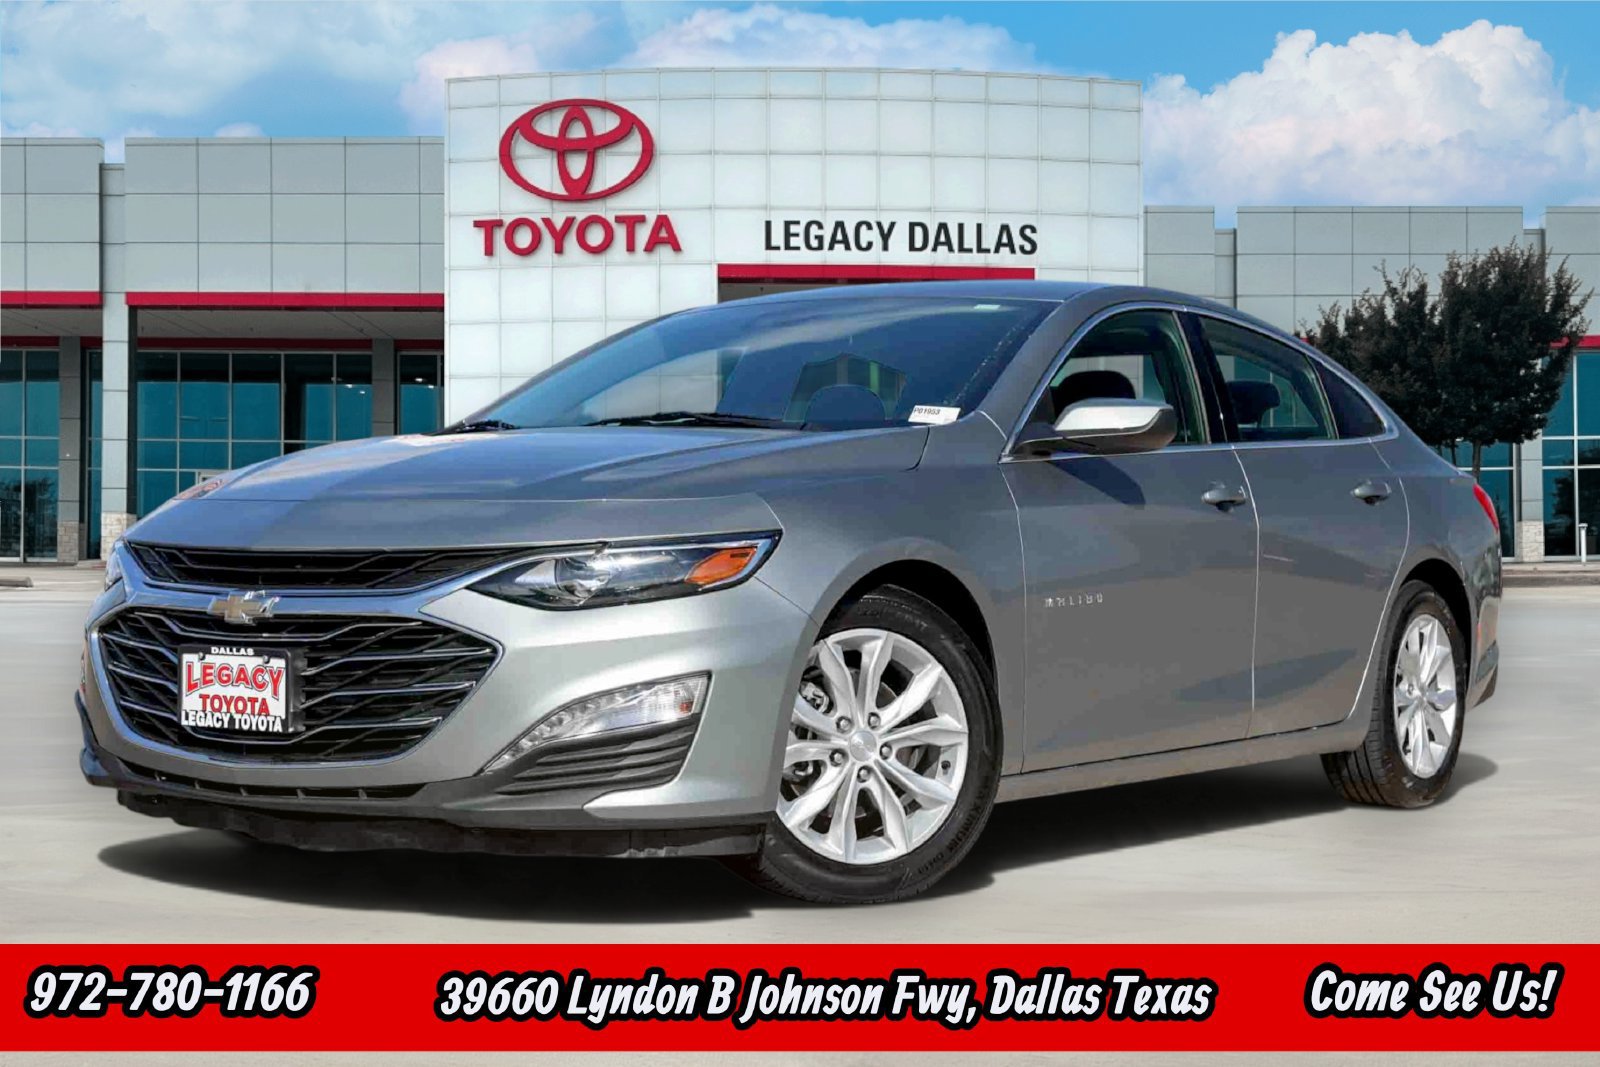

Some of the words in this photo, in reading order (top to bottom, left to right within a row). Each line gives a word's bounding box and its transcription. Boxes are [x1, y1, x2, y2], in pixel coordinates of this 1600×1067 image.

[473, 213, 682, 257] TOYOTA
[765, 220, 896, 252] LEGACY
[908, 221, 1038, 255] DALLAS
[210, 646, 255, 656] DALLAS
[185, 661, 285, 700] LEGACY
[199, 693, 271, 716] TOYOTA
[180, 710, 231, 729] LEGACY
[233, 712, 283, 733] TOYOTA
